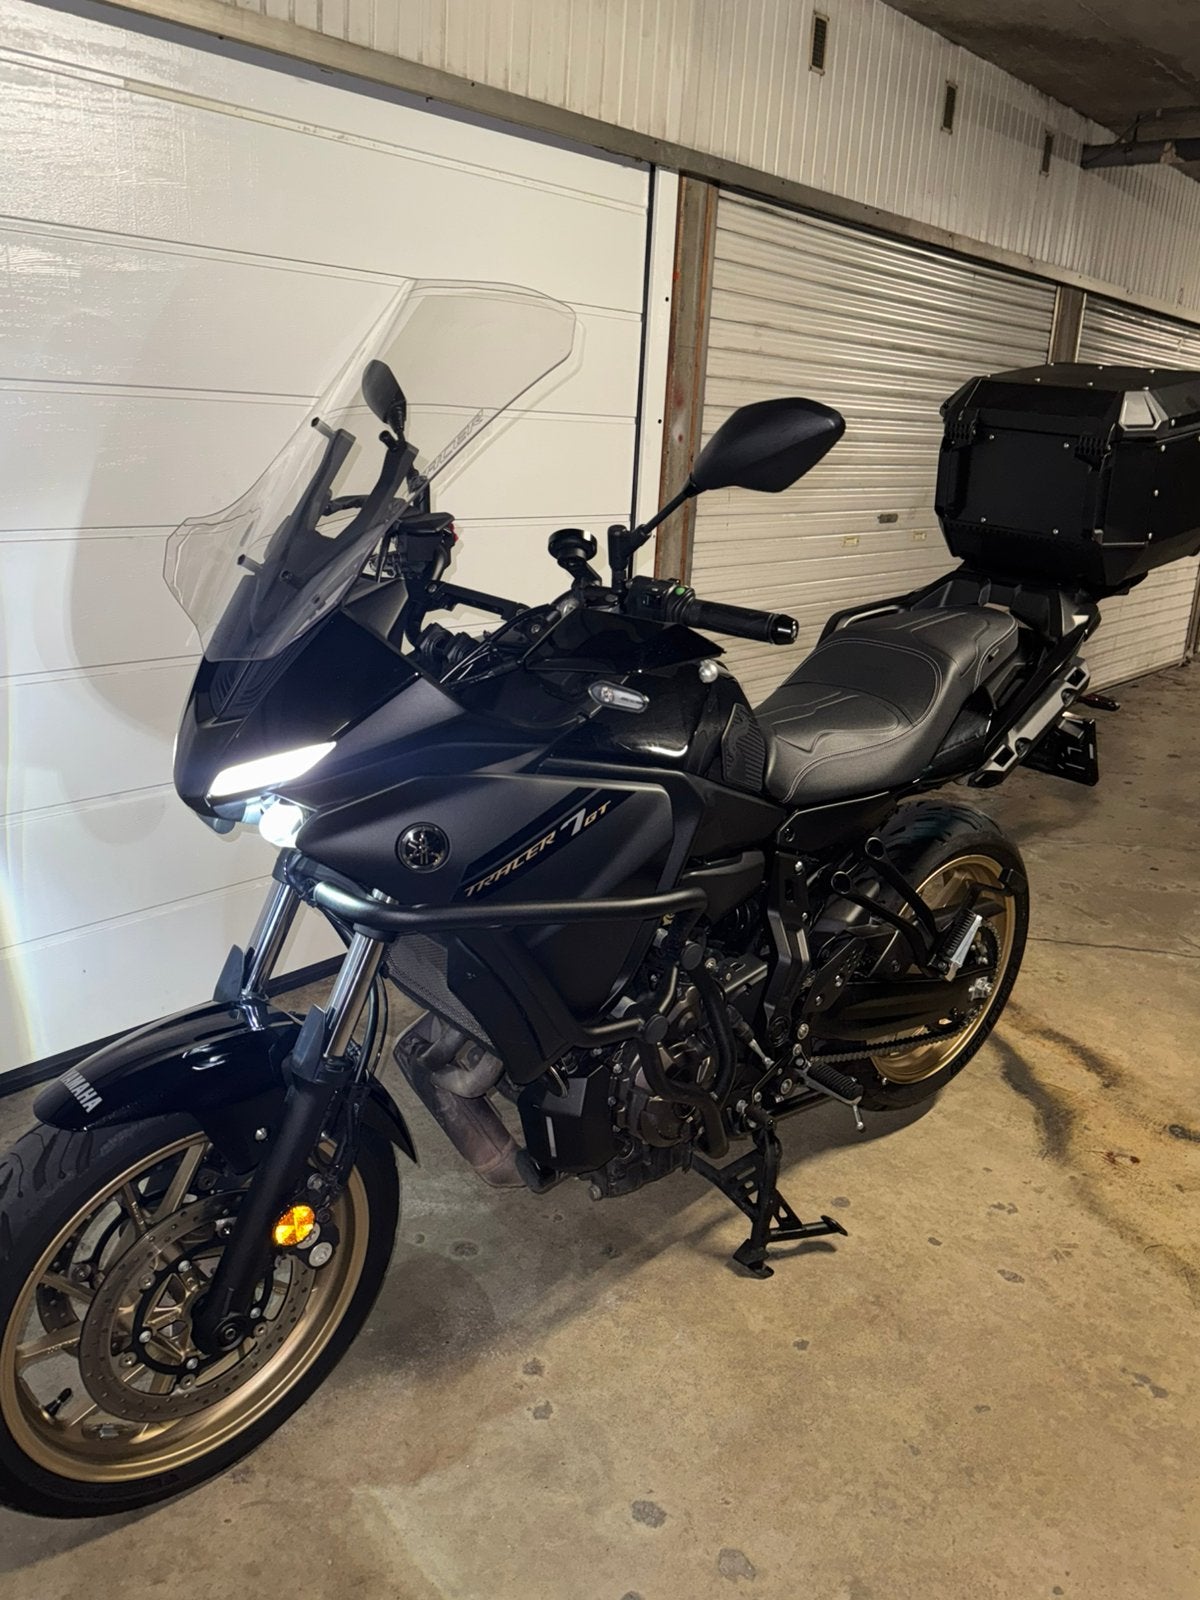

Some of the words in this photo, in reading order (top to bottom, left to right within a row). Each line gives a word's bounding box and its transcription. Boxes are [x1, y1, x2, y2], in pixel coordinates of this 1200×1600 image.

[422, 408, 483, 477] ACER
[464, 830, 557, 897] TRACER
[560, 808, 586, 836] 7
